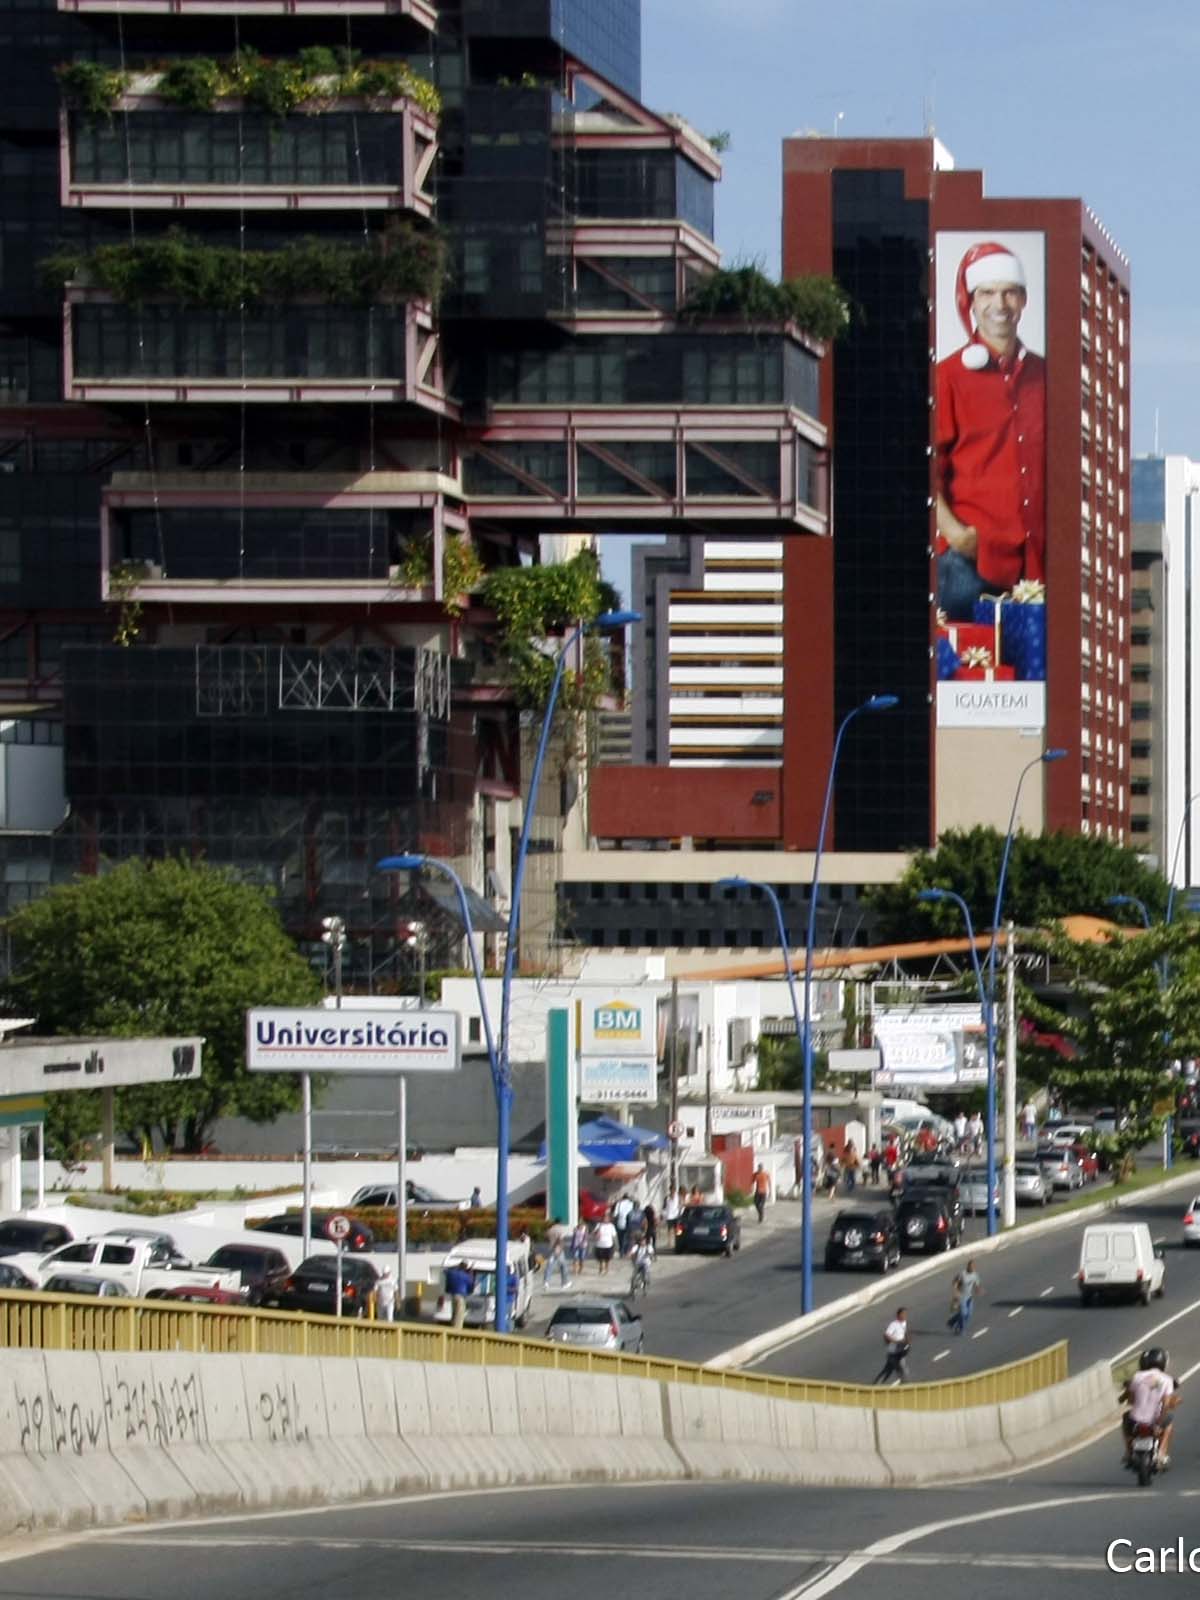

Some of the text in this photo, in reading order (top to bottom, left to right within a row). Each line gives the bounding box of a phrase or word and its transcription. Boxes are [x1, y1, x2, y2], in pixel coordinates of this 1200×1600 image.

[955, 692, 1028, 709] IGUATEMI
[597, 1010, 638, 1029] BM
[256, 1020, 448, 1047] Universitária
